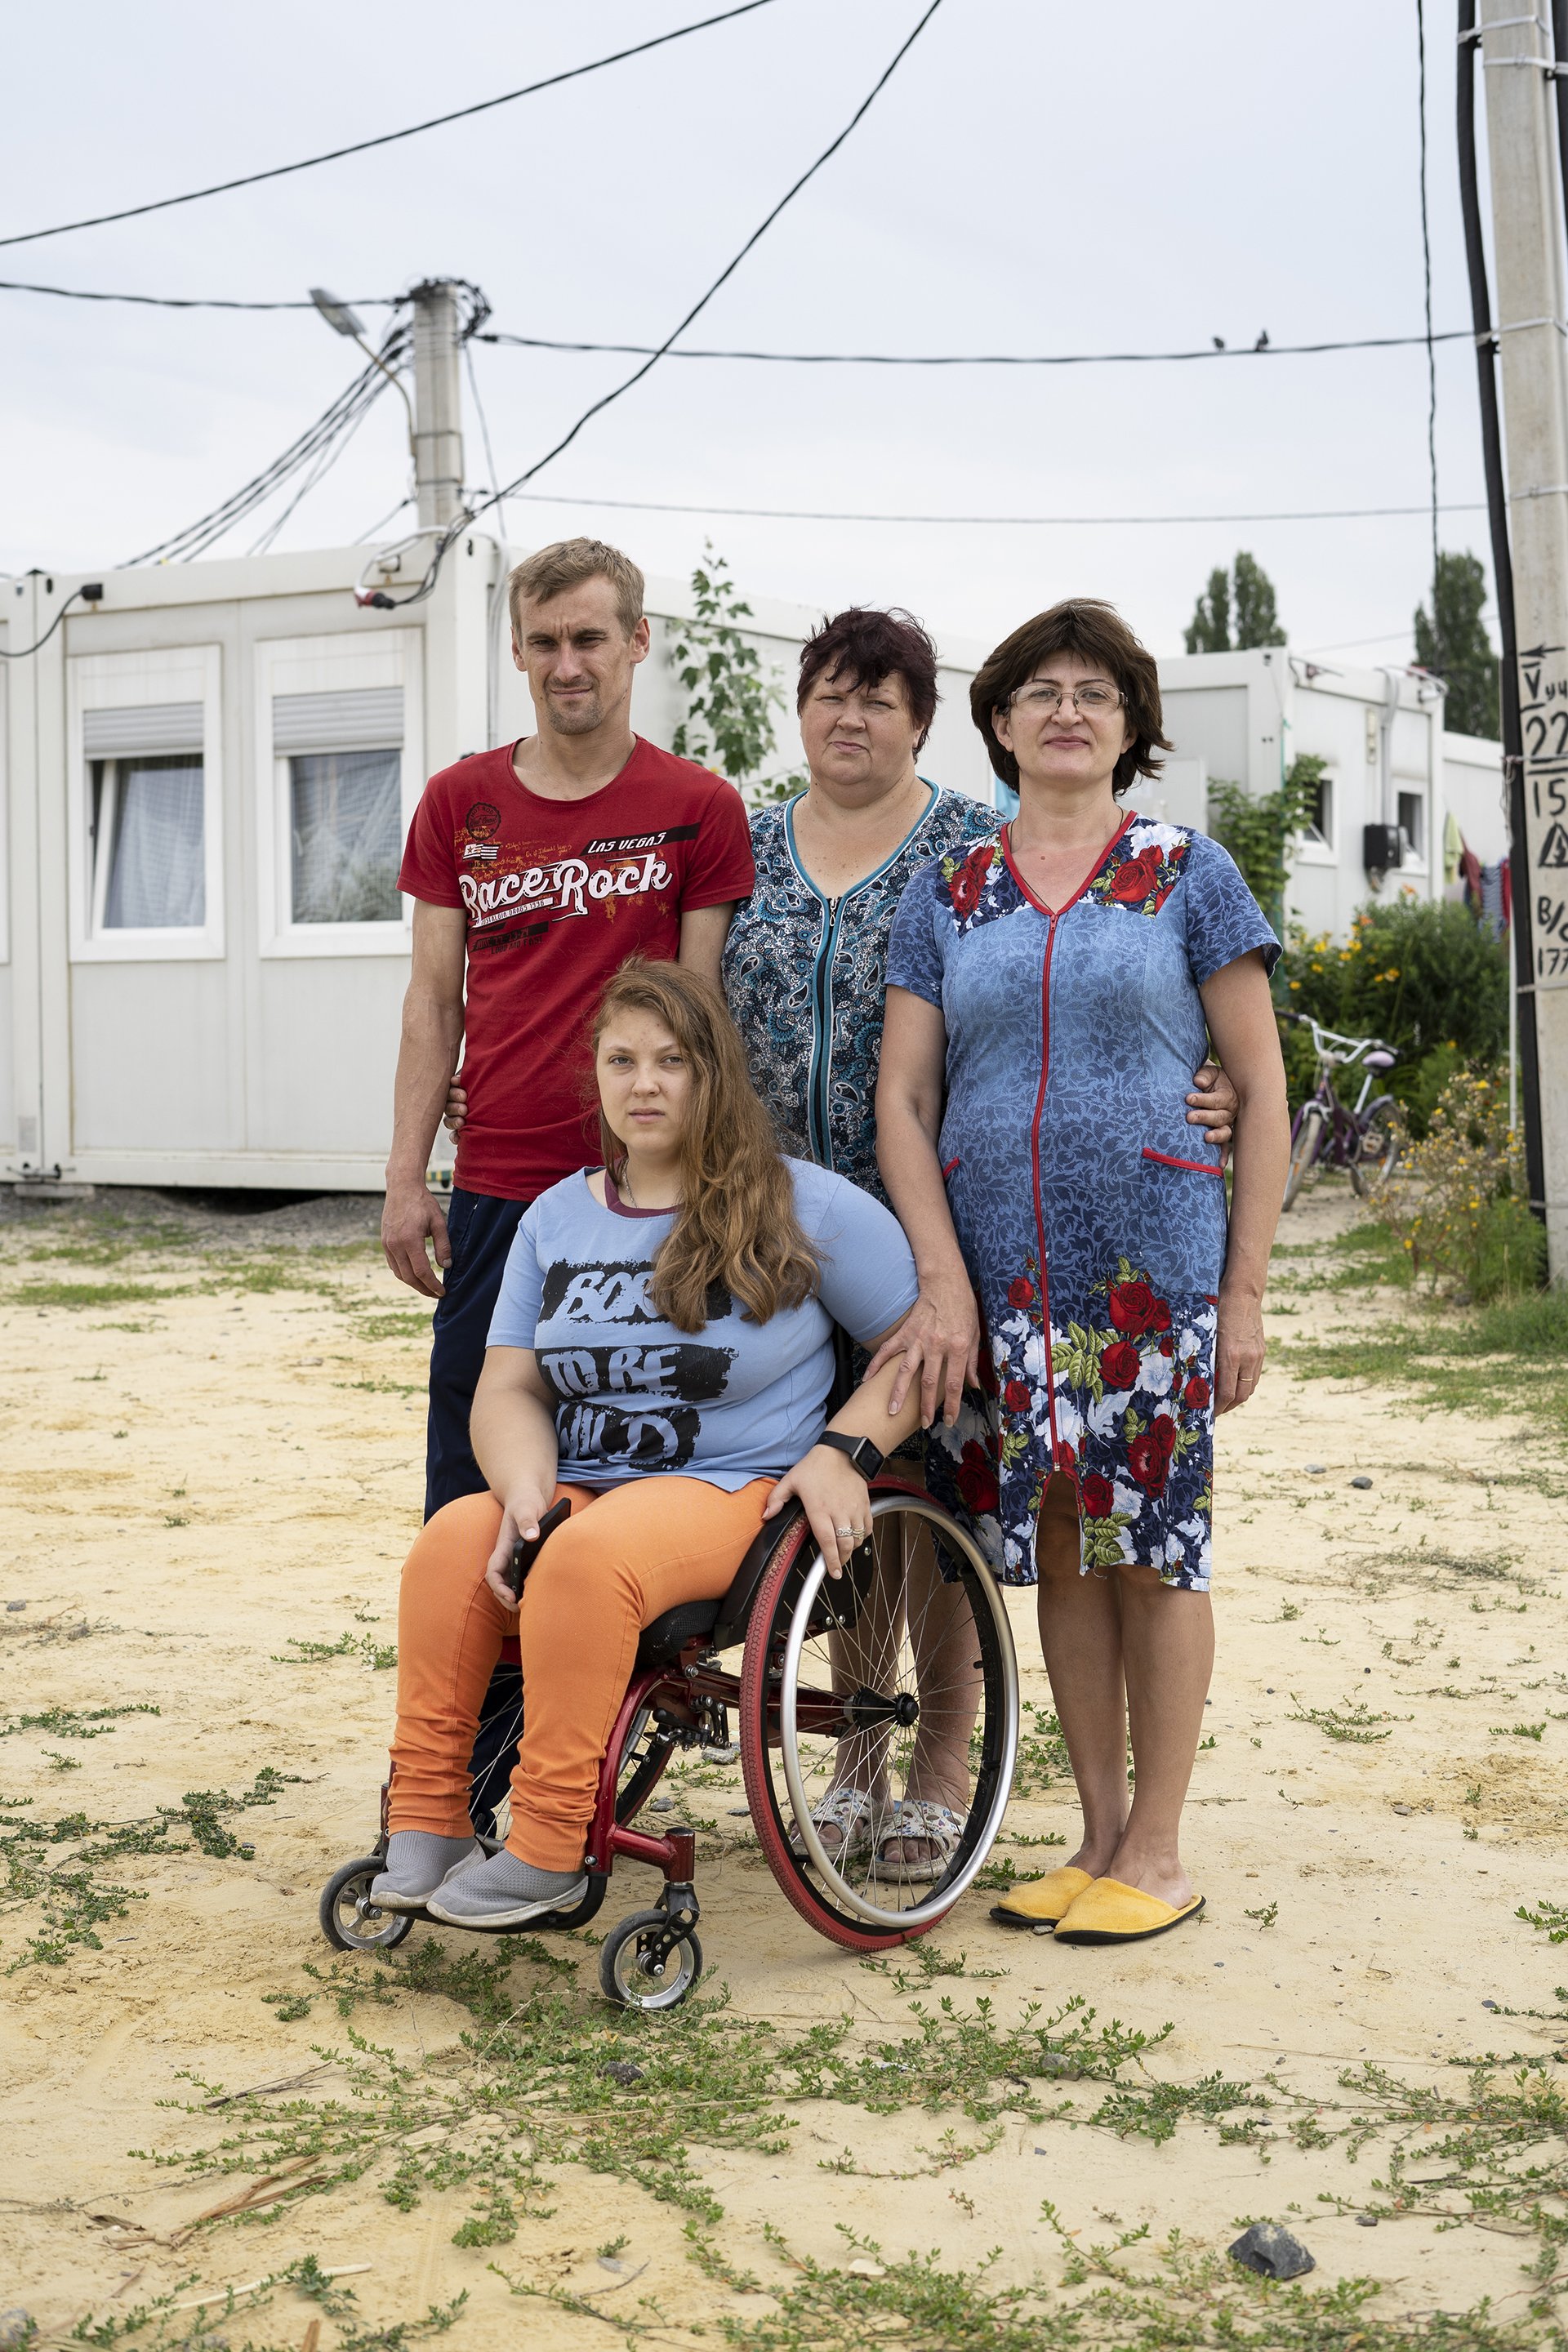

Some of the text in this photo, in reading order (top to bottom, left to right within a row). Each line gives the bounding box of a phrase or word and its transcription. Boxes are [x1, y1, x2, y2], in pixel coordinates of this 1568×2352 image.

[1533, 778, 1566, 818] 15
[587, 840, 617, 853] LAS
[618, 831, 667, 851] VEGAS
